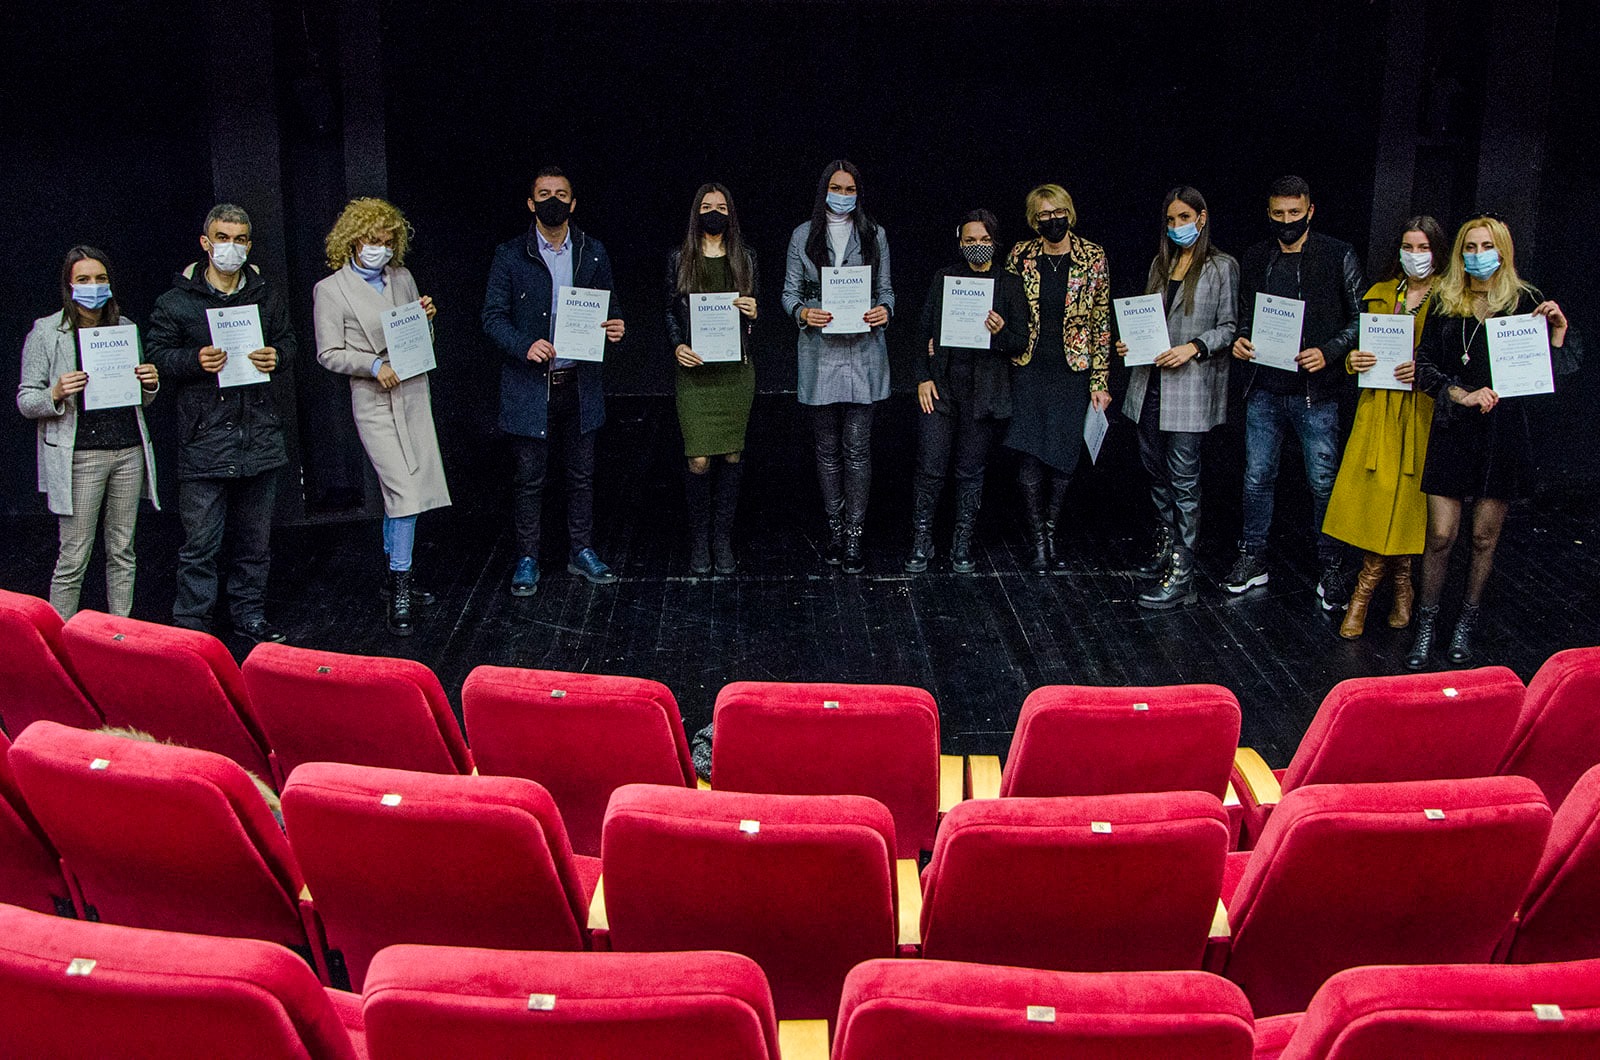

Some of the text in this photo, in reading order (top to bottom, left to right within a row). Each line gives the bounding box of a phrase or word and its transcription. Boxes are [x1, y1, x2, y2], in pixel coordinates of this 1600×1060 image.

[830, 277, 863, 285] DIPLOMA
[951, 289, 986, 297] DIPLOMA
[566, 299, 601, 309] DIPLOMA
[1123, 306, 1156, 317] DIPLOMA
[1262, 306, 1295, 319] DIPLOMA
[217, 319, 251, 329] DIPLOMA
[390, 313, 420, 329] DIPLOMA
[1368, 326, 1404, 335] DIPLOMA
[1496, 327, 1538, 339] DIPLOMA
[90, 339, 129, 349] DIPLOMA
